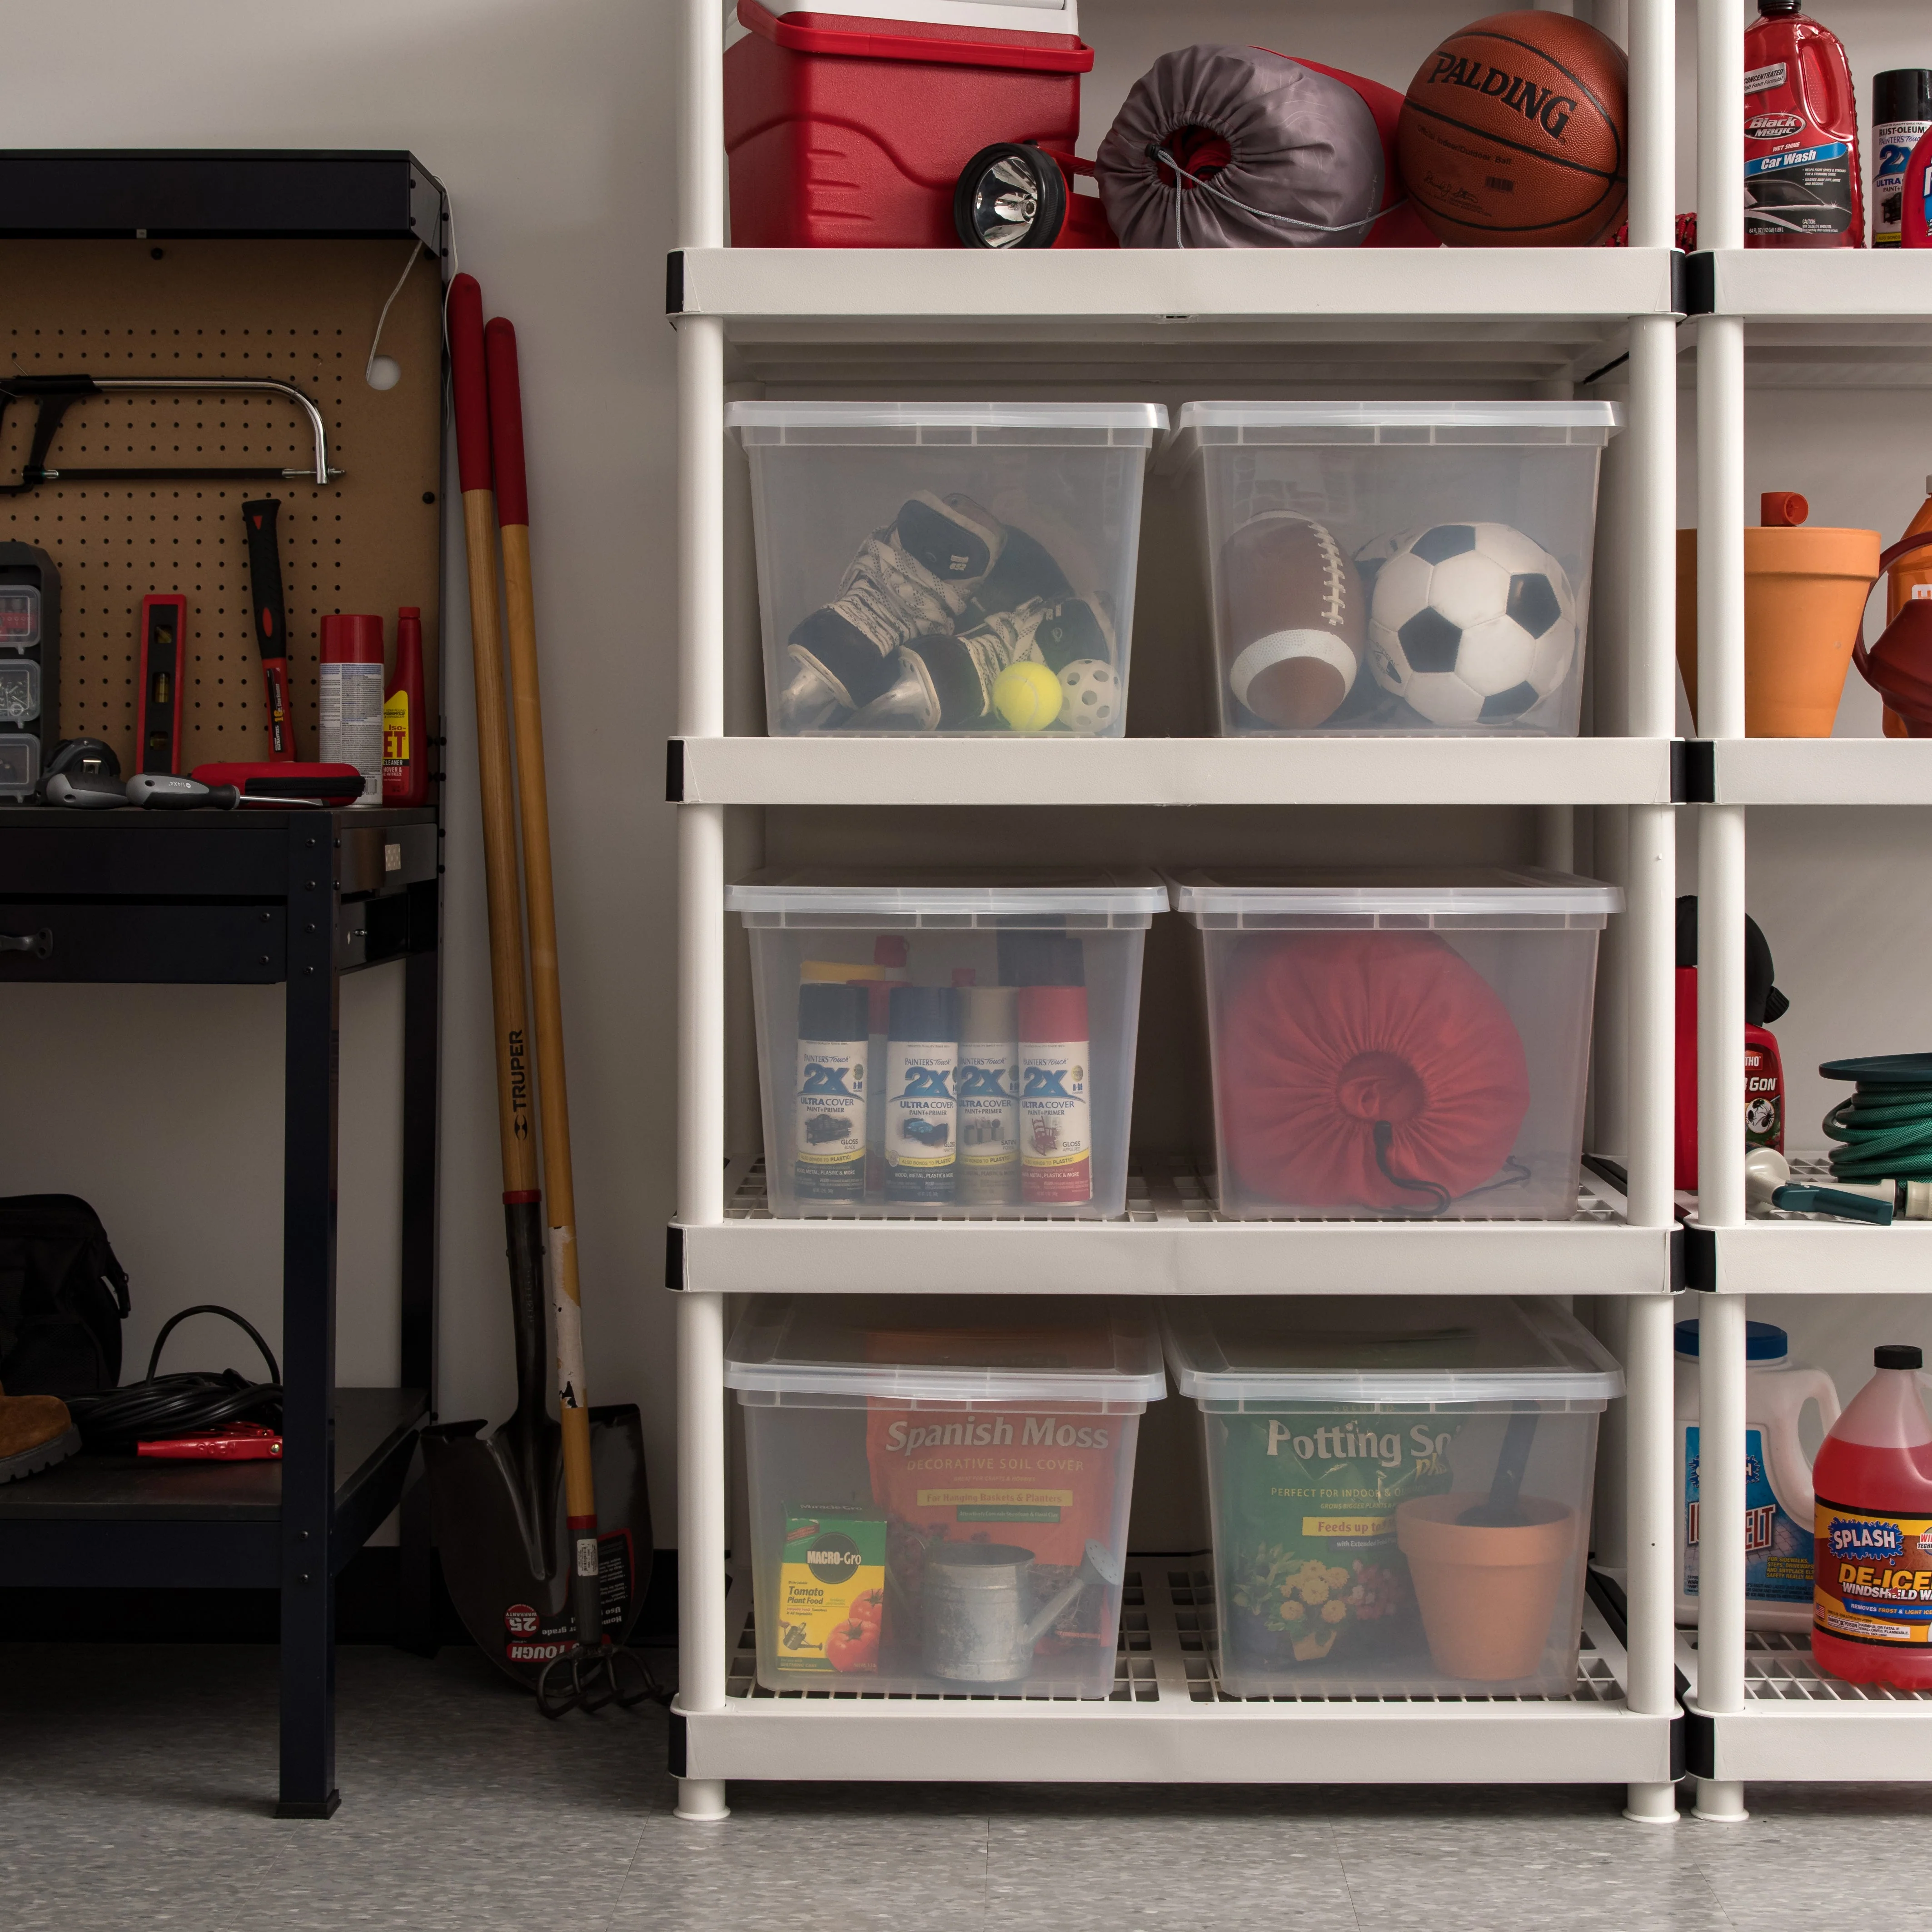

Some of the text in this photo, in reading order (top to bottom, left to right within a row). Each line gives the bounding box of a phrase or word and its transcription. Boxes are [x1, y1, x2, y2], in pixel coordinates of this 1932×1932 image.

[1744, 69, 1783, 84] CONCENTRATED
[1428, 51, 1577, 140] PALDING
[1749, 117, 1797, 129] Black
[1754, 128, 1793, 137] Magic
[1879, 126, 1925, 137] RUST-OLEUM
[1784, 142, 1801, 150] SHINE
[1495, 155, 1512, 165] Ball
[1761, 150, 1816, 170] Car Wash
[1877, 178, 1901, 187] ULTRA
[274, 710, 284, 722] 16
[383, 731, 406, 758] ET
[509, 1029, 527, 1113] TRUPER
[803, 1063, 850, 1095] 2X
[904, 1066, 951, 1097] 2X
[960, 1065, 1006, 1097] 2X
[1024, 1066, 1068, 1097] 2X
[1749, 1077, 1776, 1091] GON
[886, 1415, 1109, 1457] Spanish Moss
[1267, 1419, 1402, 1468] Potting
[907, 1458, 1084, 1472] DECORATIVE SOIL COVER
[927, 1493, 1062, 1504] For Hanging Baskets & Planters
[1271, 1487, 1316, 1498] PERFECT
[1320, 1489, 1338, 1498] FOR
[1342, 1489, 1381, 1498] INDOOR
[1385, 1489, 1391, 1497] &
[1318, 1521, 1381, 1534] Feeds up to
[1745, 1504, 1775, 1551] ELT
[1833, 1529, 1896, 1550] SPLASH
[807, 1550, 862, 1565] MACRO-Gro
[1838, 1563, 1932, 1591] DE-ICE
[789, 1586, 824, 1596] Tomato
[605, 1606, 621, 1615] Uso
[1851, 1603, 1877, 1612] REMOVES
[509, 1617, 537, 1632] 25
[541, 1626, 568, 1637] grade
[511, 1644, 566, 1659] TOUGH
